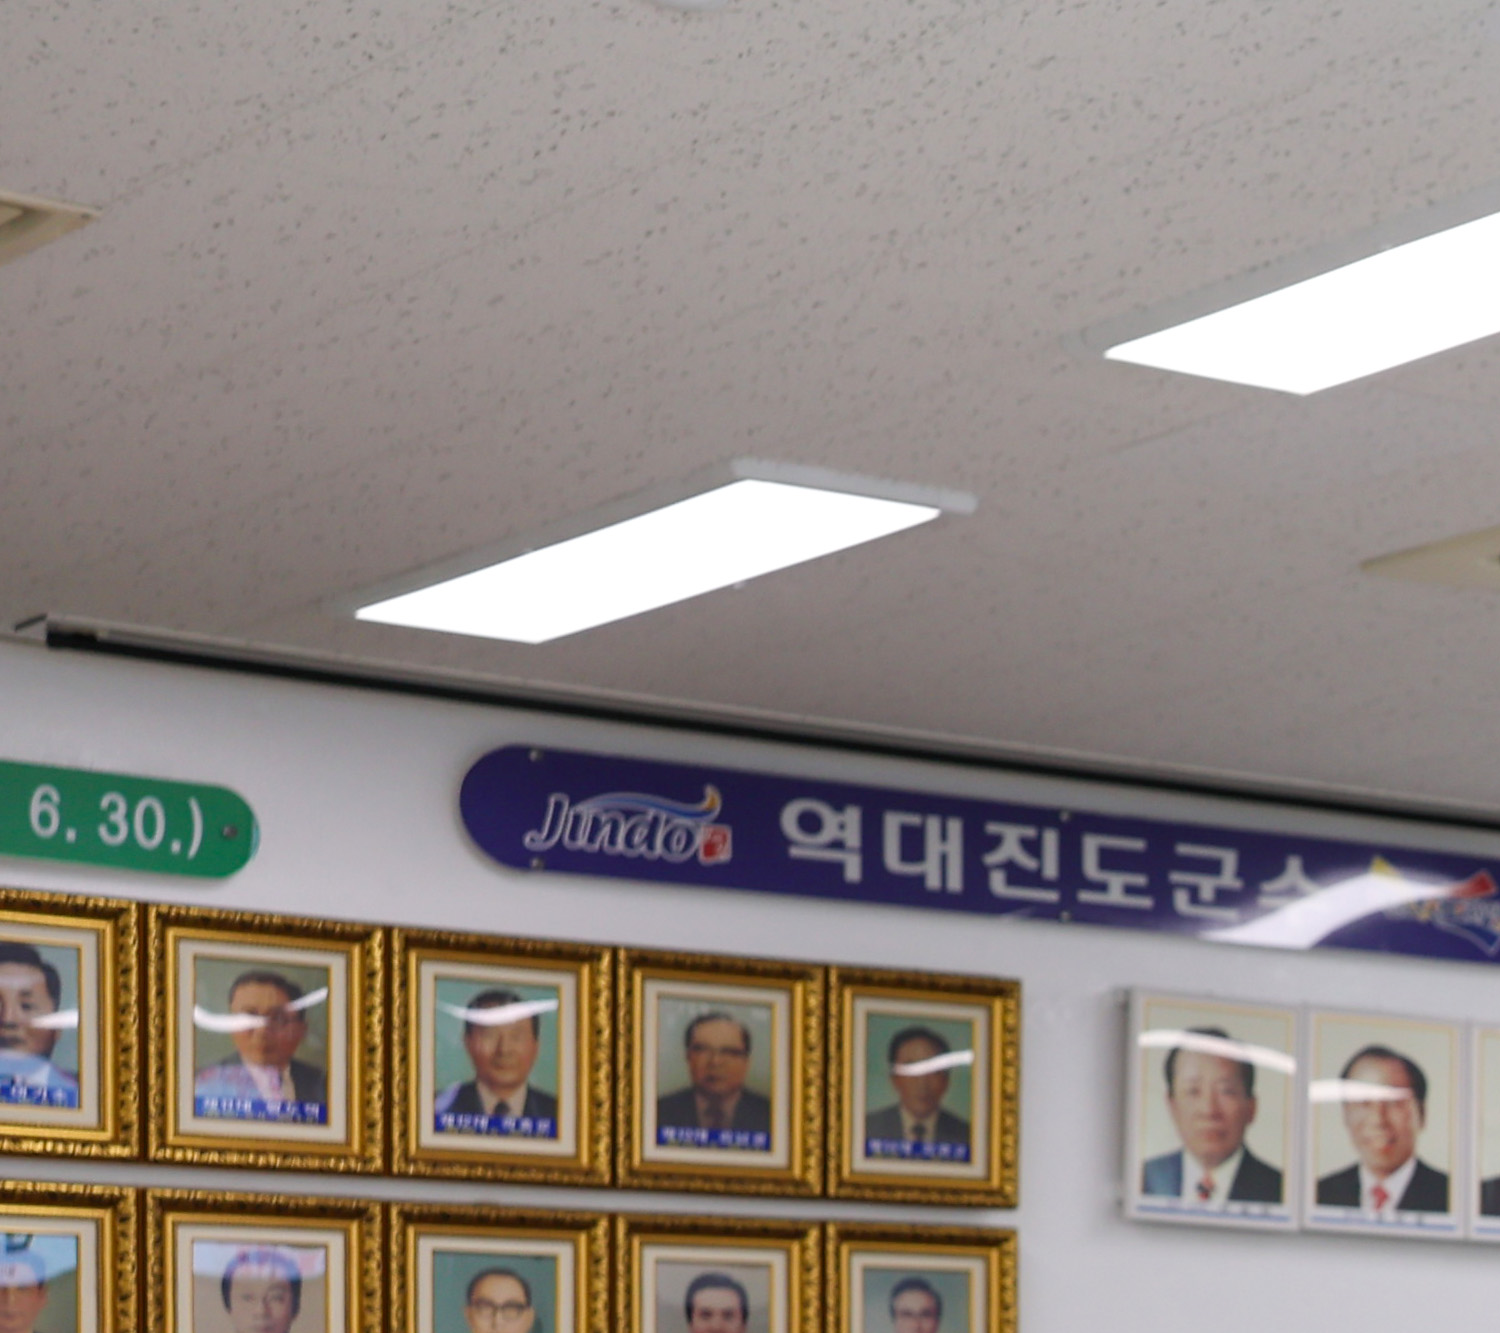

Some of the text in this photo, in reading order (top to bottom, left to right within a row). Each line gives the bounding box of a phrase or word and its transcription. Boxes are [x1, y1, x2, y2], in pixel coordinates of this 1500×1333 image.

[29, 783, 204, 861] 6. 30.)
[523, 792, 700, 864] Jindo
